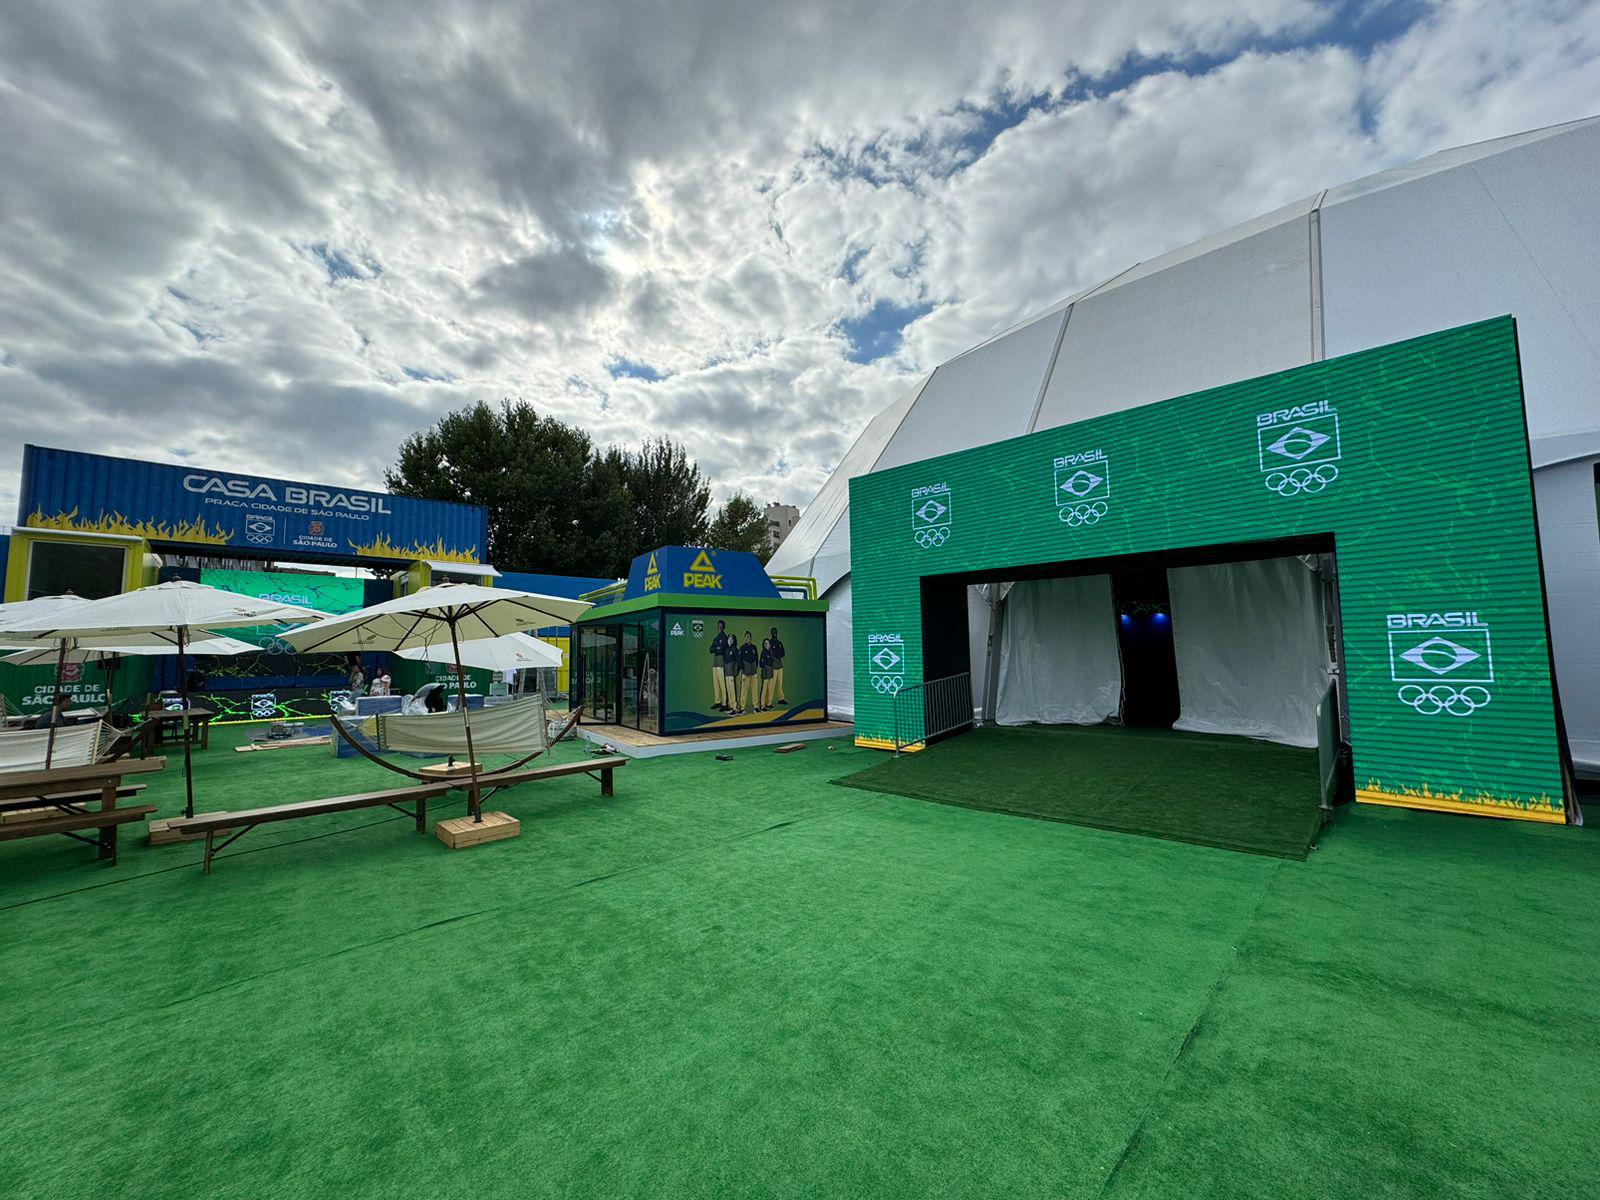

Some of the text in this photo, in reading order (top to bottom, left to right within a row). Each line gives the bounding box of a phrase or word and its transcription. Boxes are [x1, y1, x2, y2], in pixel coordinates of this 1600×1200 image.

[1256, 399, 1337, 427] BRASIL
[1053, 448, 1108, 469] BRASIL
[183, 474, 392, 515] CASA BRASIL
[911, 481, 951, 498] BRASIL
[251, 502, 291, 513] CIDADE
[294, 506, 308, 515] DE
[335, 511, 370, 521] PAULO
[298, 534, 323, 542] CIDADE
[311, 540, 338, 549] PAULO
[645, 572, 661, 593] PEAK
[683, 572, 724, 590] PEAK
[258, 593, 313, 604] BRASIL
[1386, 611, 1489, 629] BRASIL
[868, 633, 904, 643] BRASIL
[84, 684, 100, 693] DE
[70, 693, 107, 704] AULO
